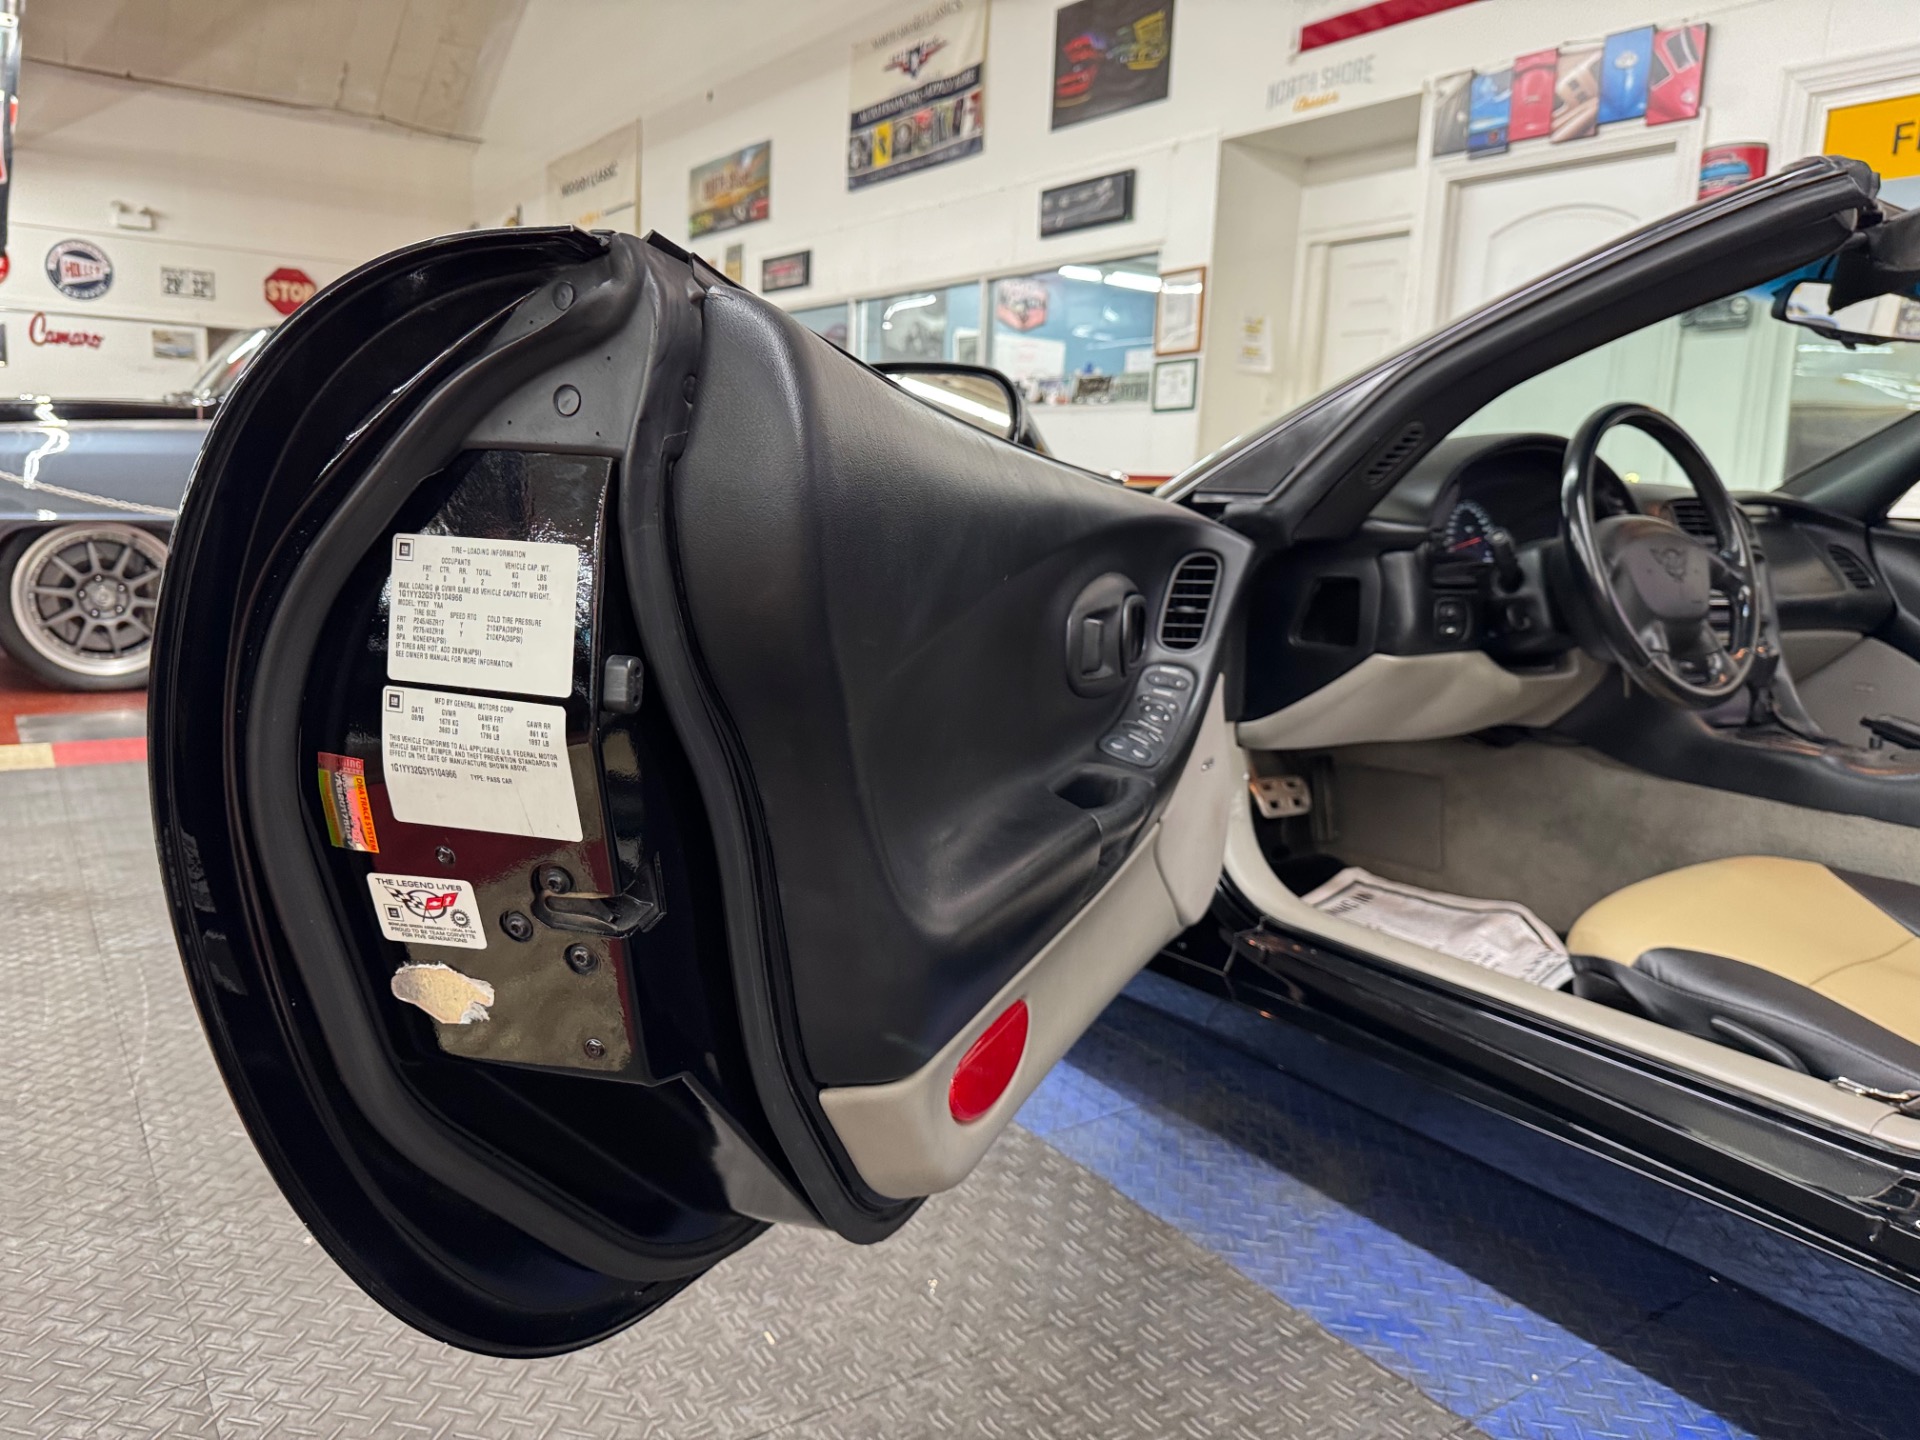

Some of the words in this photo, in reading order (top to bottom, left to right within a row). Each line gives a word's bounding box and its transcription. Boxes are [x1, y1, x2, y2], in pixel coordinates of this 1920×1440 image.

[1893, 121, 1920, 155] F
[265, 280, 317, 303] STOP
[29, 311, 104, 349] Camaro
[490, 549, 526, 558] INFORMATION
[442, 557, 470, 566] OCCUPANTS
[504, 562, 526, 570] VEHICLE
[476, 568, 492, 576] TOTAL
[512, 572, 518, 580] KG
[536, 573, 547, 582] LBS
[480, 578, 485, 586] 2
[412, 582, 433, 591] LOADING
[458, 586, 470, 594] SAME
[472, 587, 480, 595] AS
[480, 588, 501, 597] VEHICLE
[502, 590, 528, 598] CAPACITY
[434, 601, 444, 609] YAA
[396, 615, 406, 623] FRT
[414, 608, 424, 616] TIRE
[426, 609, 436, 618] SIZE
[450, 611, 466, 620] SPEED
[487, 615, 500, 624] COLD
[502, 616, 514, 625] TIRE
[515, 618, 542, 627] PRESSURE
[396, 633, 406, 641] SPA
[402, 642, 416, 650] TIRES
[440, 646, 450, 654] ADD
[396, 650, 404, 658] SEE
[429, 654, 450, 662] MANUAL
[451, 656, 461, 664] FOR
[462, 656, 476, 666] MORE
[478, 658, 512, 668] INFORMATION
[434, 697, 446, 706] MFD
[446, 698, 454, 706] BY
[454, 700, 476, 710] GENERAL
[478, 703, 499, 712] MOTORS
[500, 705, 514, 714] CORP
[411, 706, 424, 714] DATE
[441, 709, 456, 718] GVWR
[478, 713, 493, 722] GAWR
[494, 716, 504, 724] FRT
[526, 720, 542, 730] GAWR
[544, 722, 552, 730] RR
[452, 720, 459, 728] KG
[492, 725, 500, 733] KG
[541, 731, 548, 740] KG
[452, 728, 458, 736] LB
[494, 734, 500, 742] LB
[542, 740, 550, 748] LB
[390, 733, 401, 742] THIS
[402, 736, 421, 745] VEHICLE
[422, 738, 450, 748] CONFORMS
[458, 743, 468, 751] ALL
[470, 745, 500, 755] APPLICABLE
[513, 750, 537, 759] FEDERAL
[538, 752, 558, 761] MOTOR
[390, 742, 409, 751] VEHICLE
[454, 750, 466, 758] AND
[466, 751, 482, 760] THEFT
[484, 753, 516, 764] PREVENTION
[518, 757, 551, 768] STANDARDS
[390, 749, 407, 758] EFFECT
[408, 751, 415, 759] ON
[416, 752, 426, 761] THE
[427, 754, 440, 762] DATE
[449, 756, 488, 768] MANUFACTURE
[489, 761, 509, 770] SHOWN
[486, 776, 500, 784] PASS
[501, 777, 513, 785] CAR
[356, 777, 366, 795] DNA
[361, 797, 370, 820] TRACE
[366, 822, 378, 850] SYSTEM
[375, 878, 394, 886] THE
[396, 879, 434, 890] LEGEND
[436, 883, 463, 892] LIVES
[428, 935, 468, 944] GENERATIONS
[446, 932, 476, 940] CORVETTE
